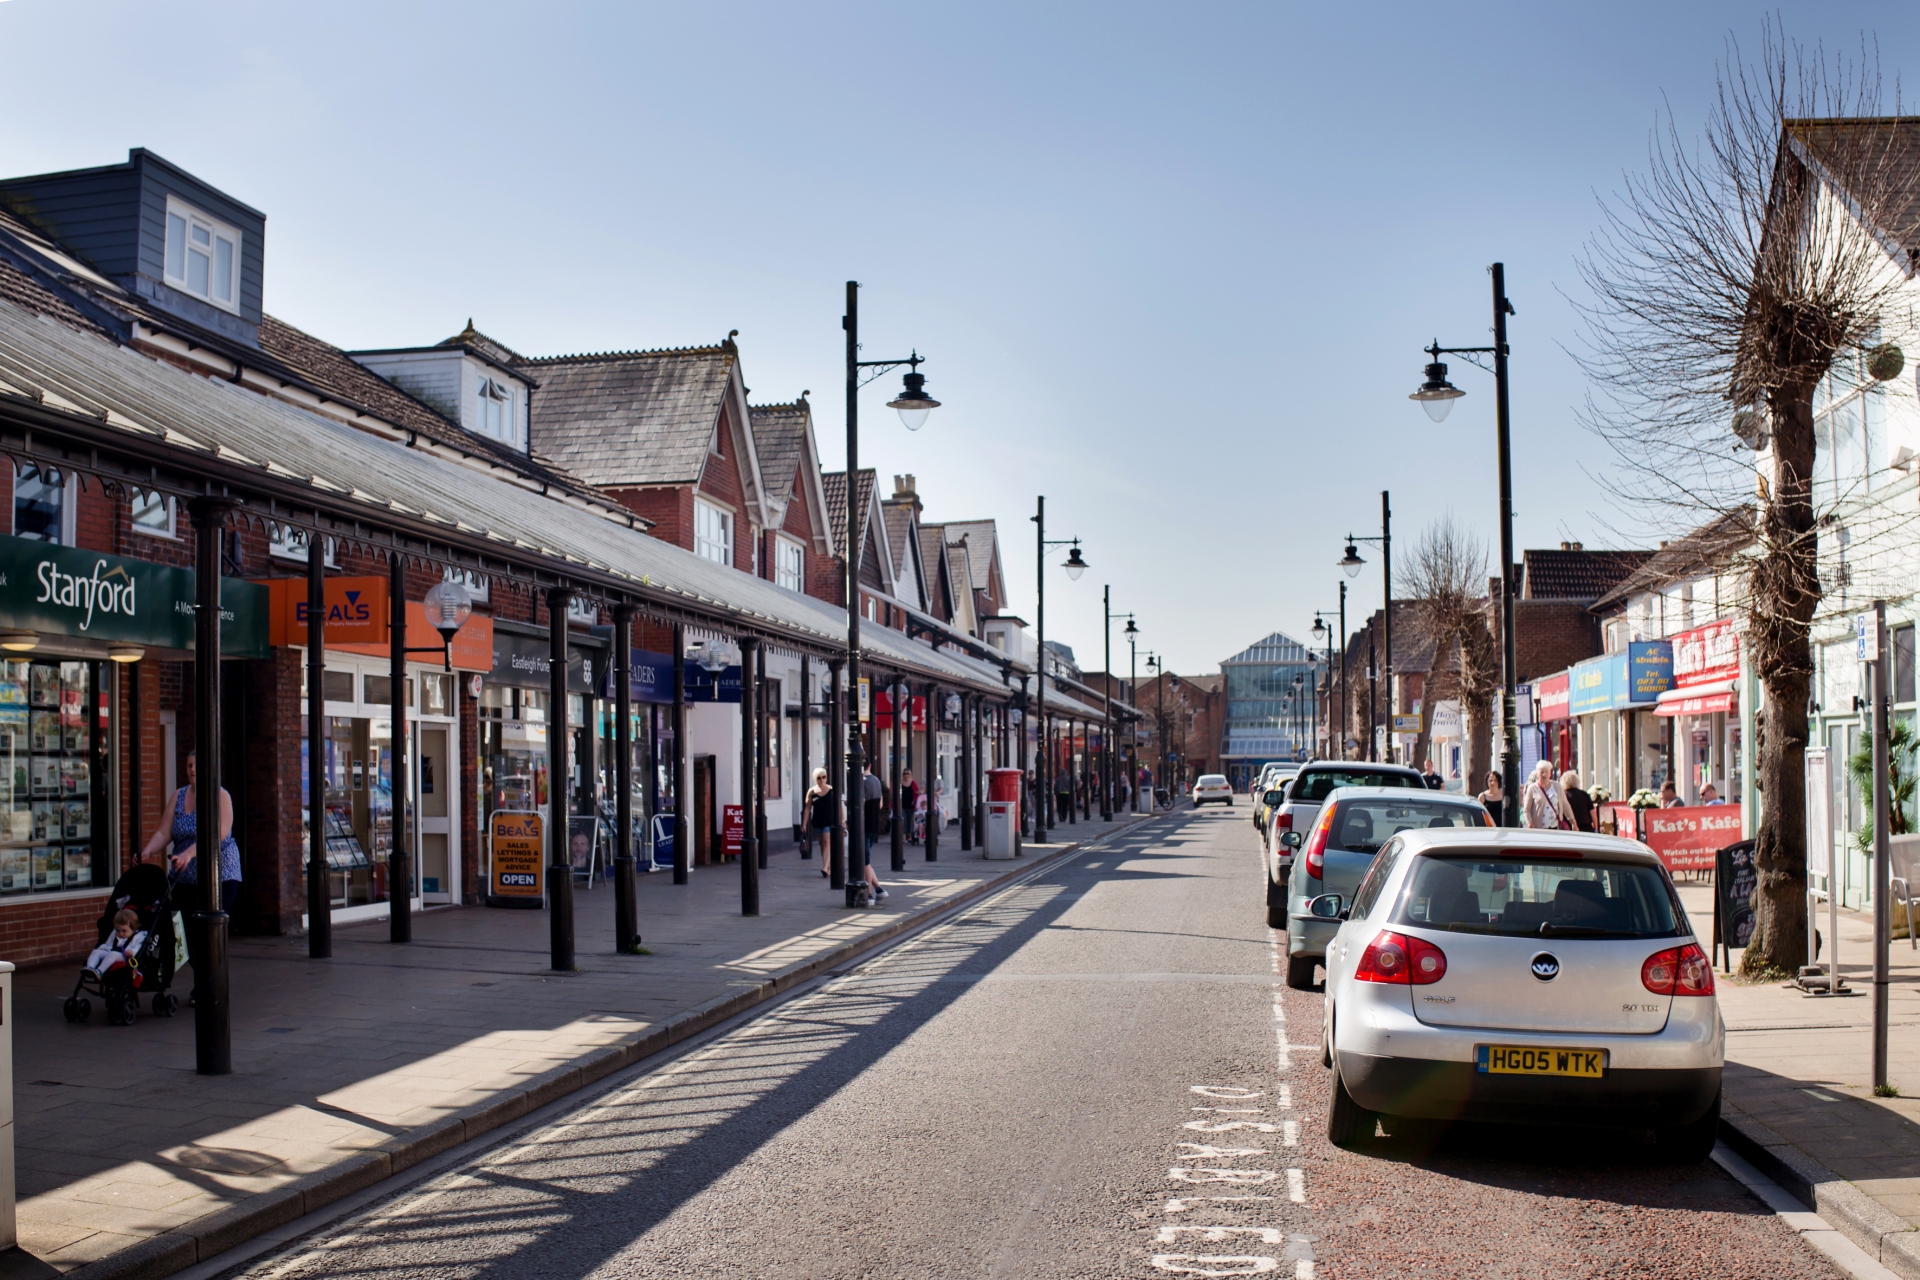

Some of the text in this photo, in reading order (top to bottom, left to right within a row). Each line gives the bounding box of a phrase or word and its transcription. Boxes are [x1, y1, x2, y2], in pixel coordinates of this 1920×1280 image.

[36, 559, 136, 631] Stanford
[512, 653, 537, 674] Eastleigh
[727, 808, 744, 816] Kat
[1653, 815, 1741, 834] Kat's Kafe
[497, 824, 539, 837] BEALS
[1663, 848, 1688, 856] Watch
[1690, 848, 1702, 857] out
[1671, 856, 1715, 866] Daily Speci
[502, 874, 534, 885] OPEN
[1424, 995, 1456, 1004] GOLF
[1641, 1004, 1660, 1012] TDI
[1492, 1049, 1598, 1074] HG05 WTK
